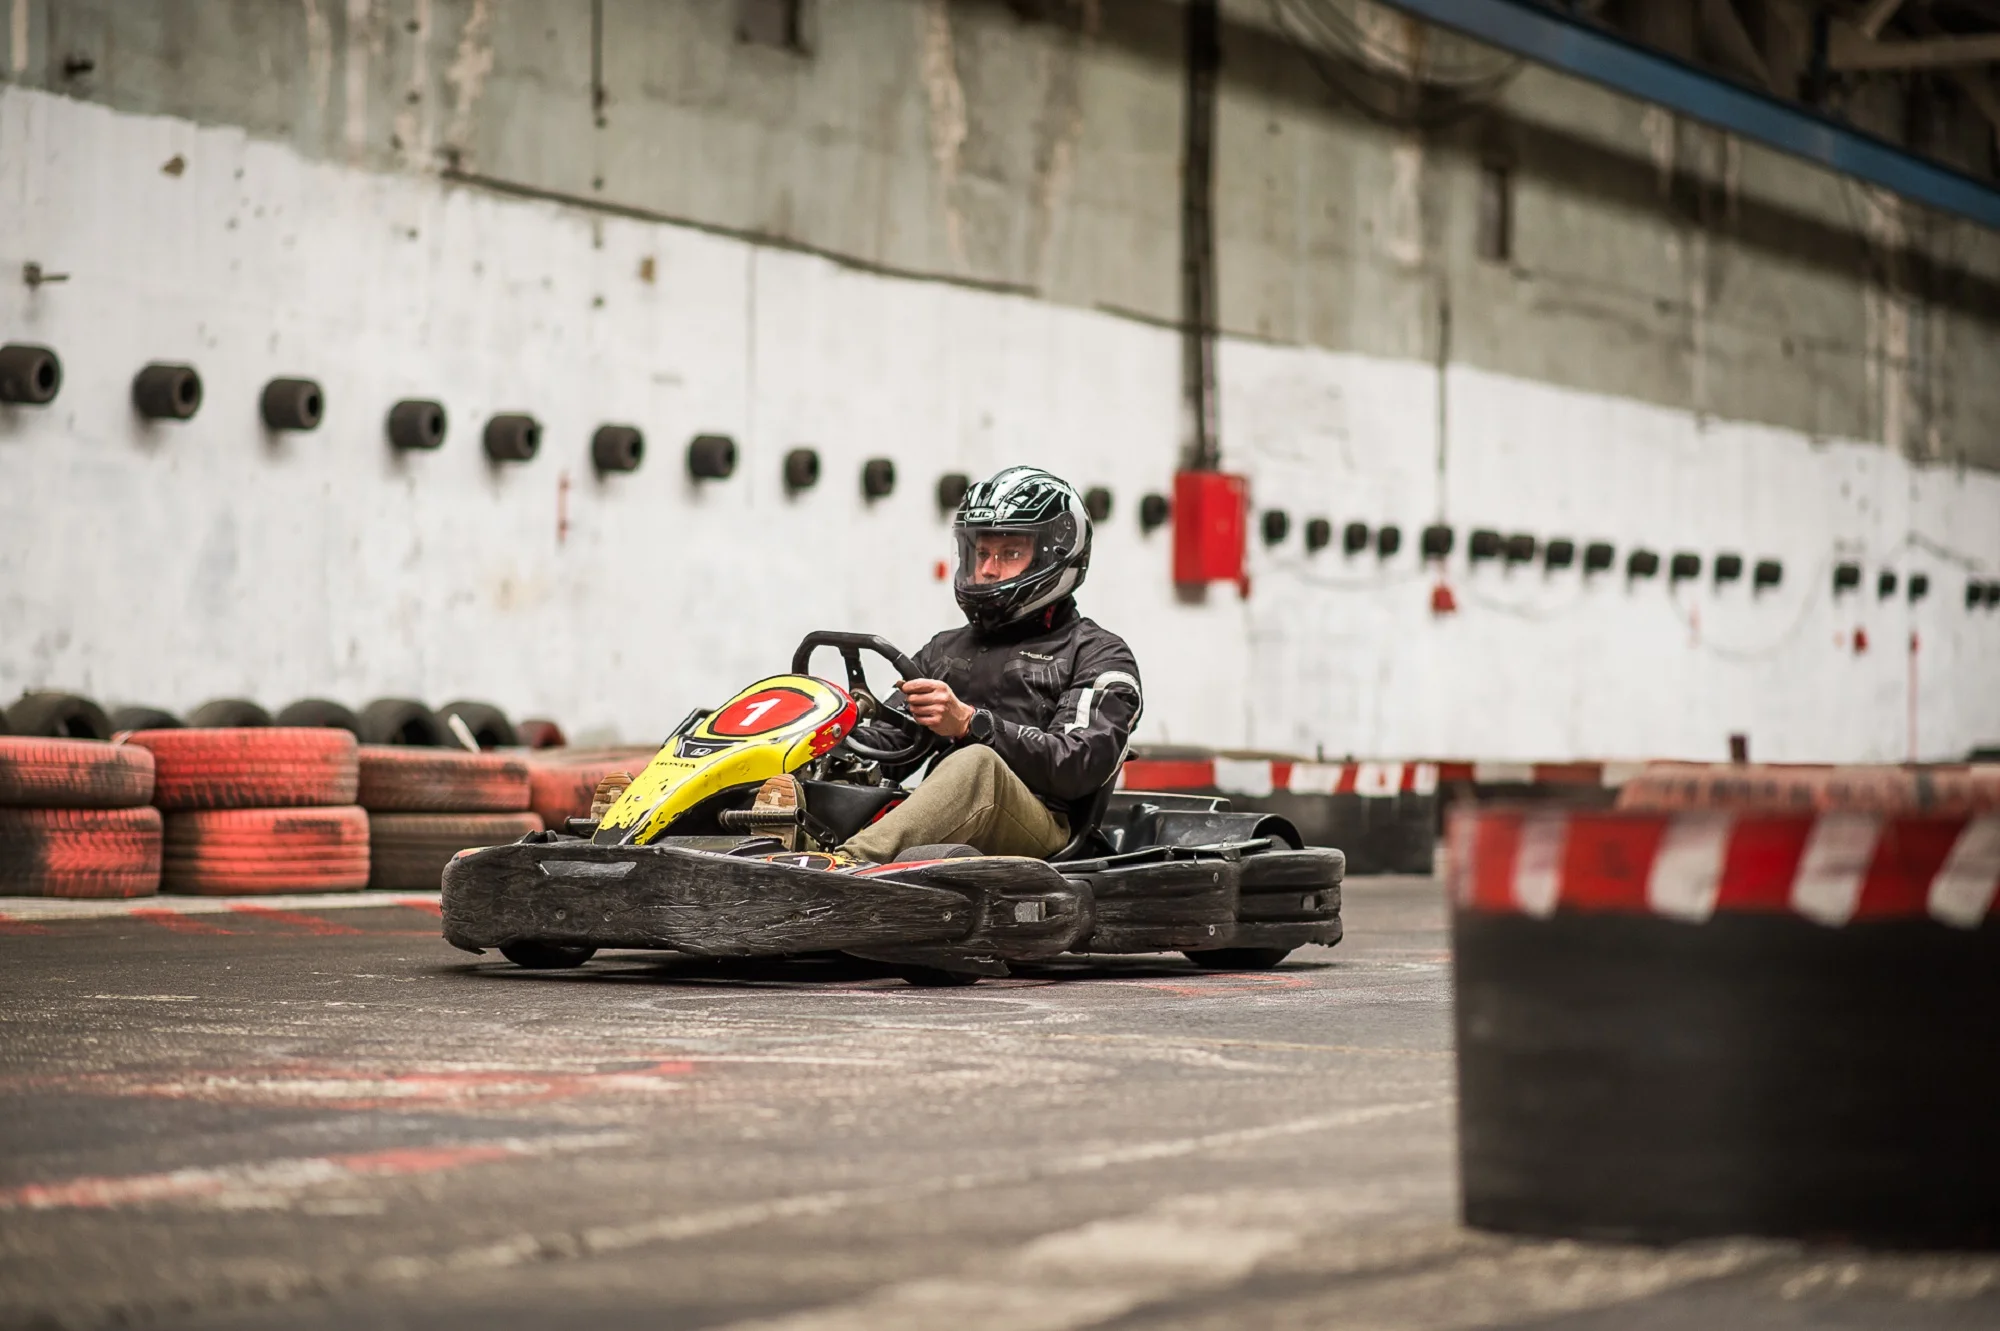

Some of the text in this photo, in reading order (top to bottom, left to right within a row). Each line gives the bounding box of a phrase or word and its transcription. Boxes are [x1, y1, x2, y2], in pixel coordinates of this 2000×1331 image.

[739, 698, 781, 726] 1
[656, 761, 696, 769] HONDA
[793, 856, 809, 867] 1
